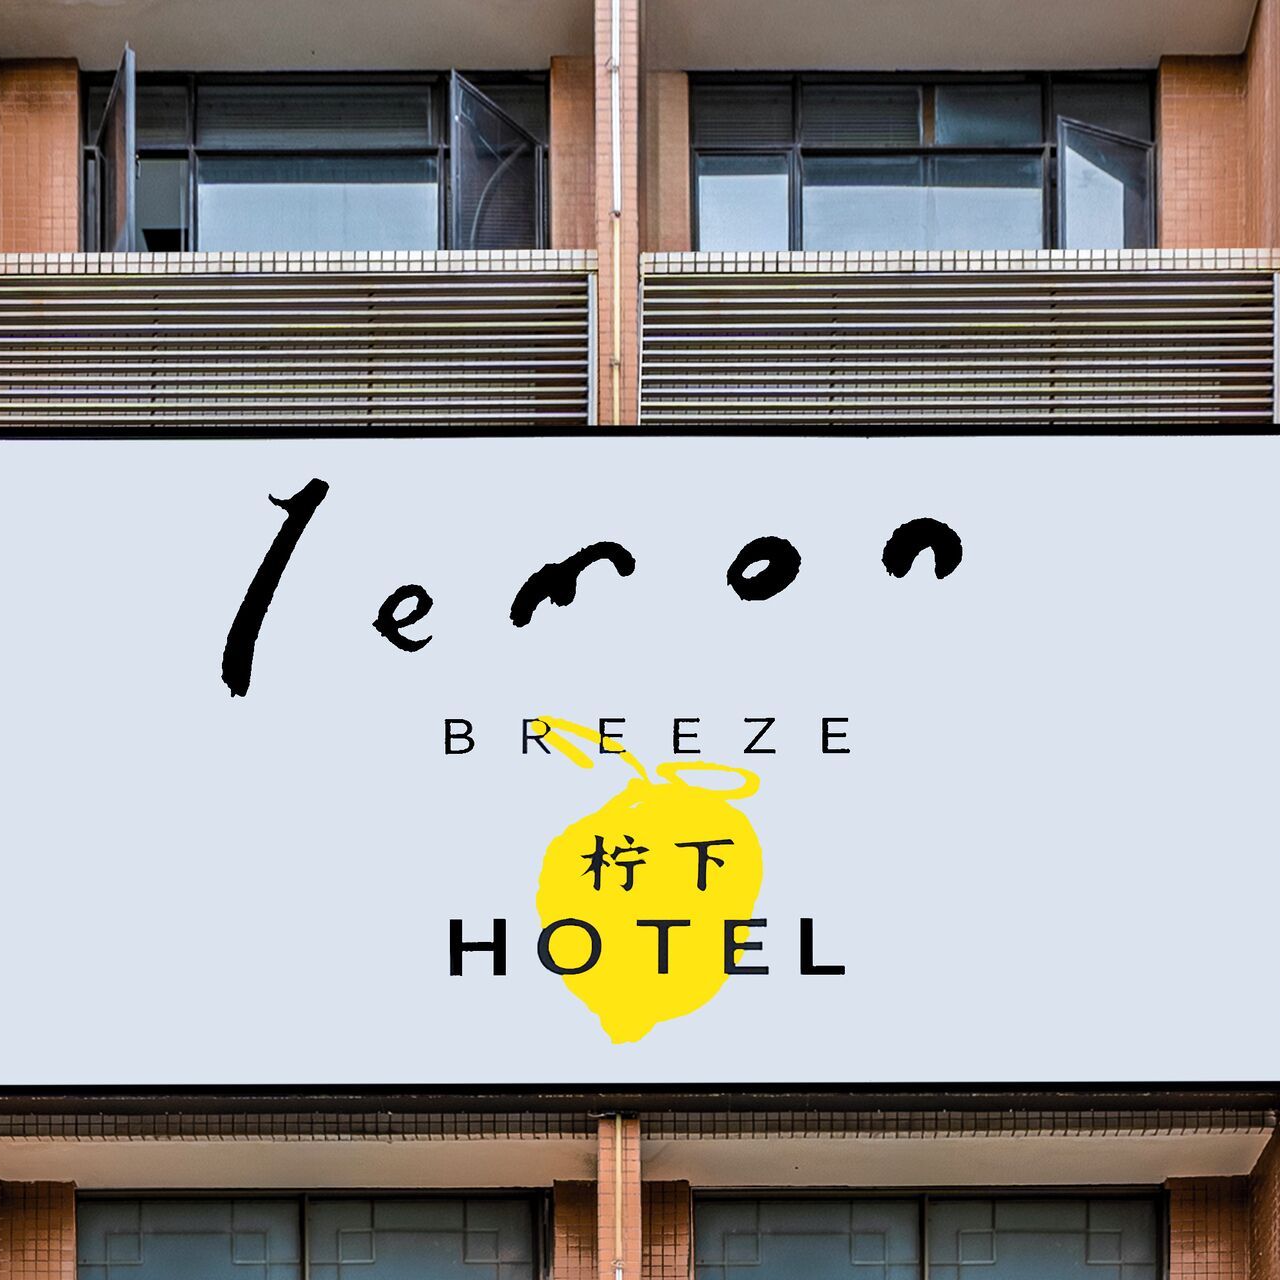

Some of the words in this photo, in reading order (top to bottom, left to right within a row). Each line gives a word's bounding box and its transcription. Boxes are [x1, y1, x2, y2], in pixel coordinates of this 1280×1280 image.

[222, 477, 963, 697] lemon
[444, 716, 852, 756] BREEZE
[581, 834, 735, 892] 柠下
[449, 917, 847, 977] HOTEL
